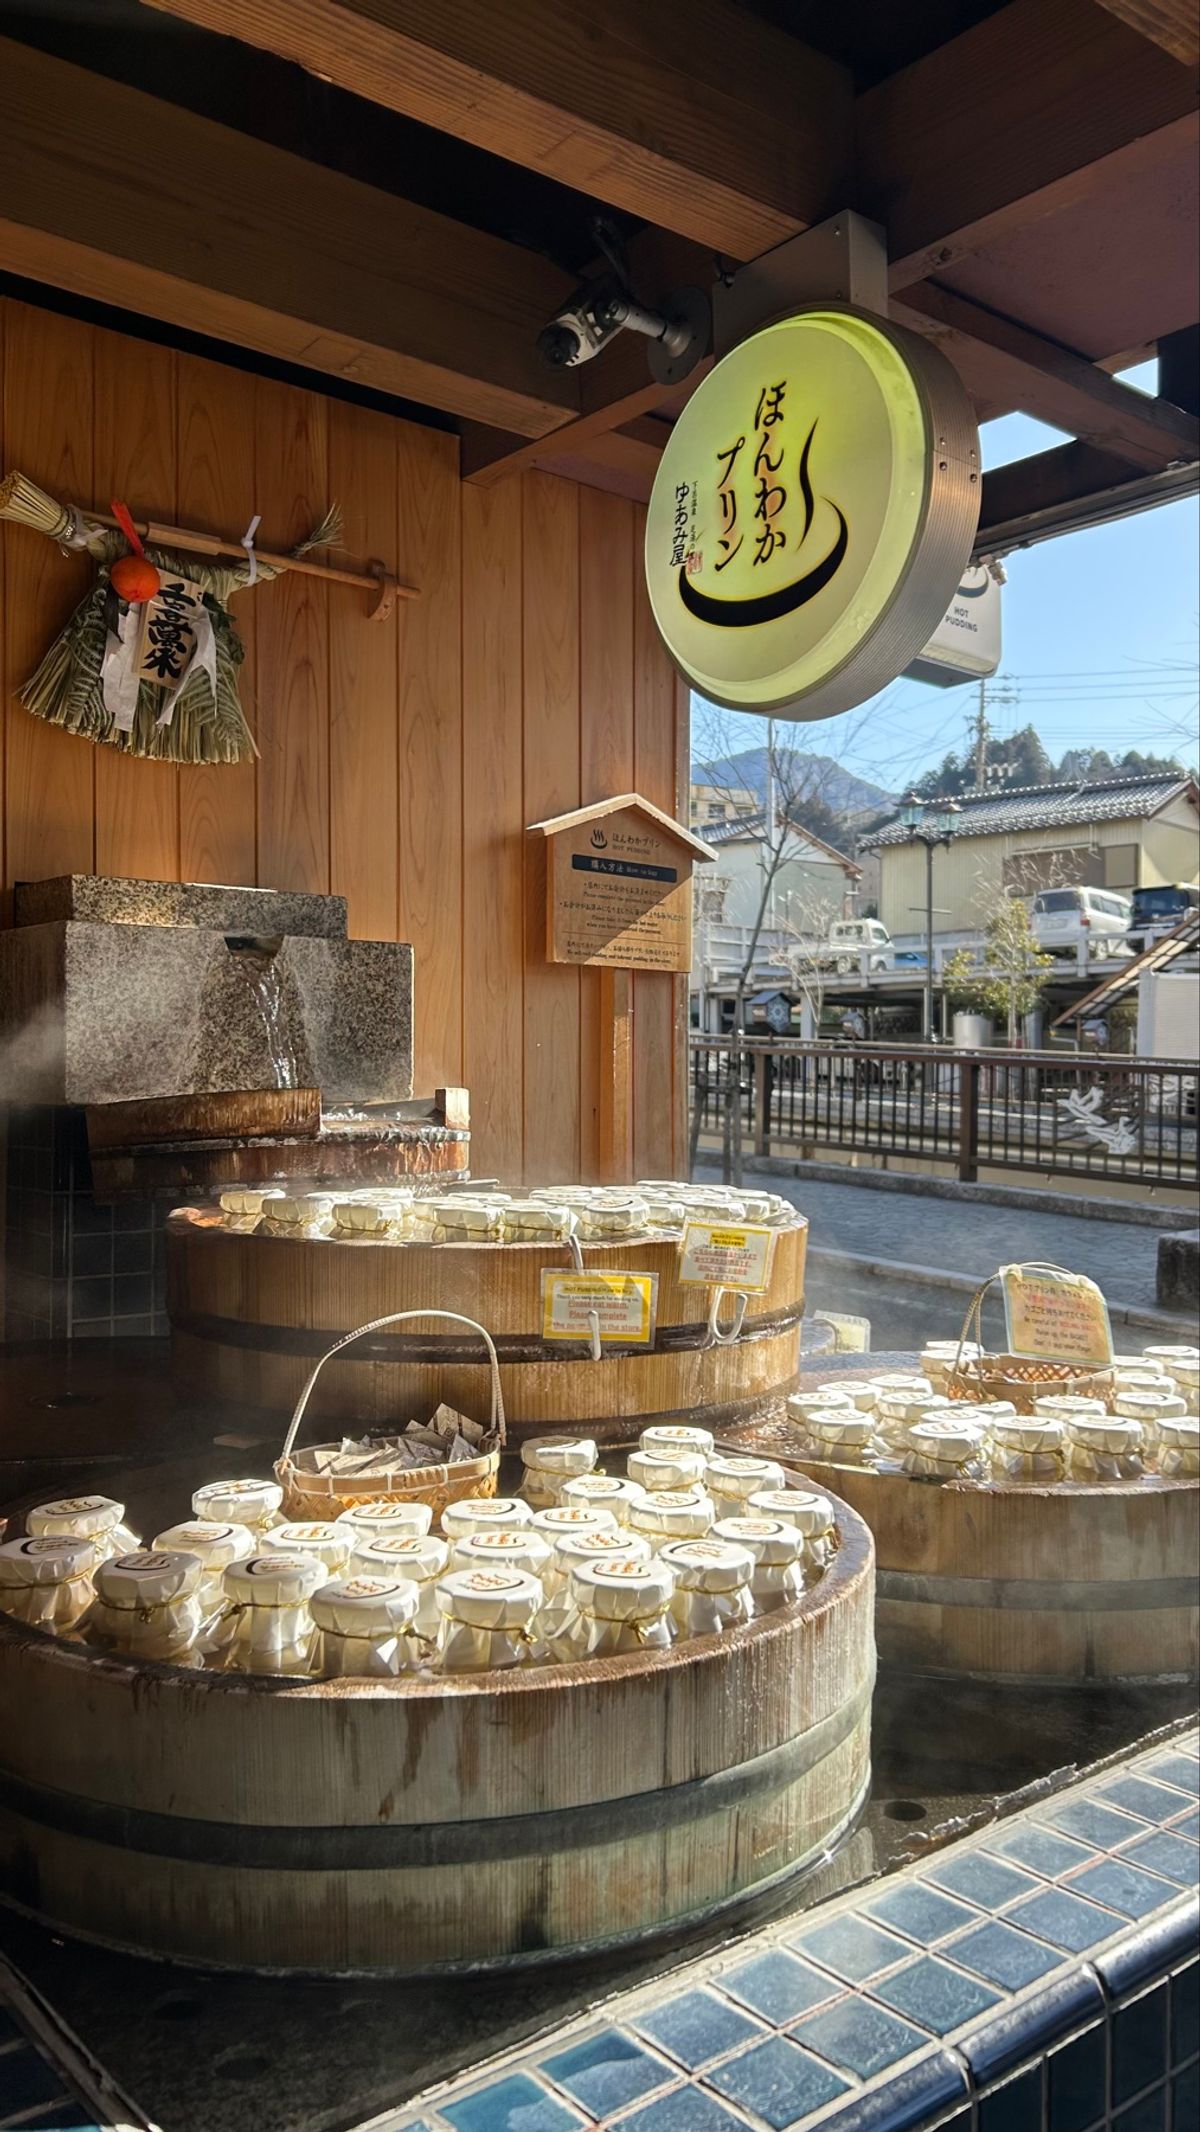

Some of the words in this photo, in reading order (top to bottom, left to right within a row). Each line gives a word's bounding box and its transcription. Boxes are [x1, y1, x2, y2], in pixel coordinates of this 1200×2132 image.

[753, 380, 787, 567] ほんわか
[670, 481, 690, 567] ゆあみ屋
[715, 435, 746, 572] プリン
[945, 615, 978, 633] PUDDING
[954, 606, 969, 618] HOT
[568, 1300, 592, 1309] Please
